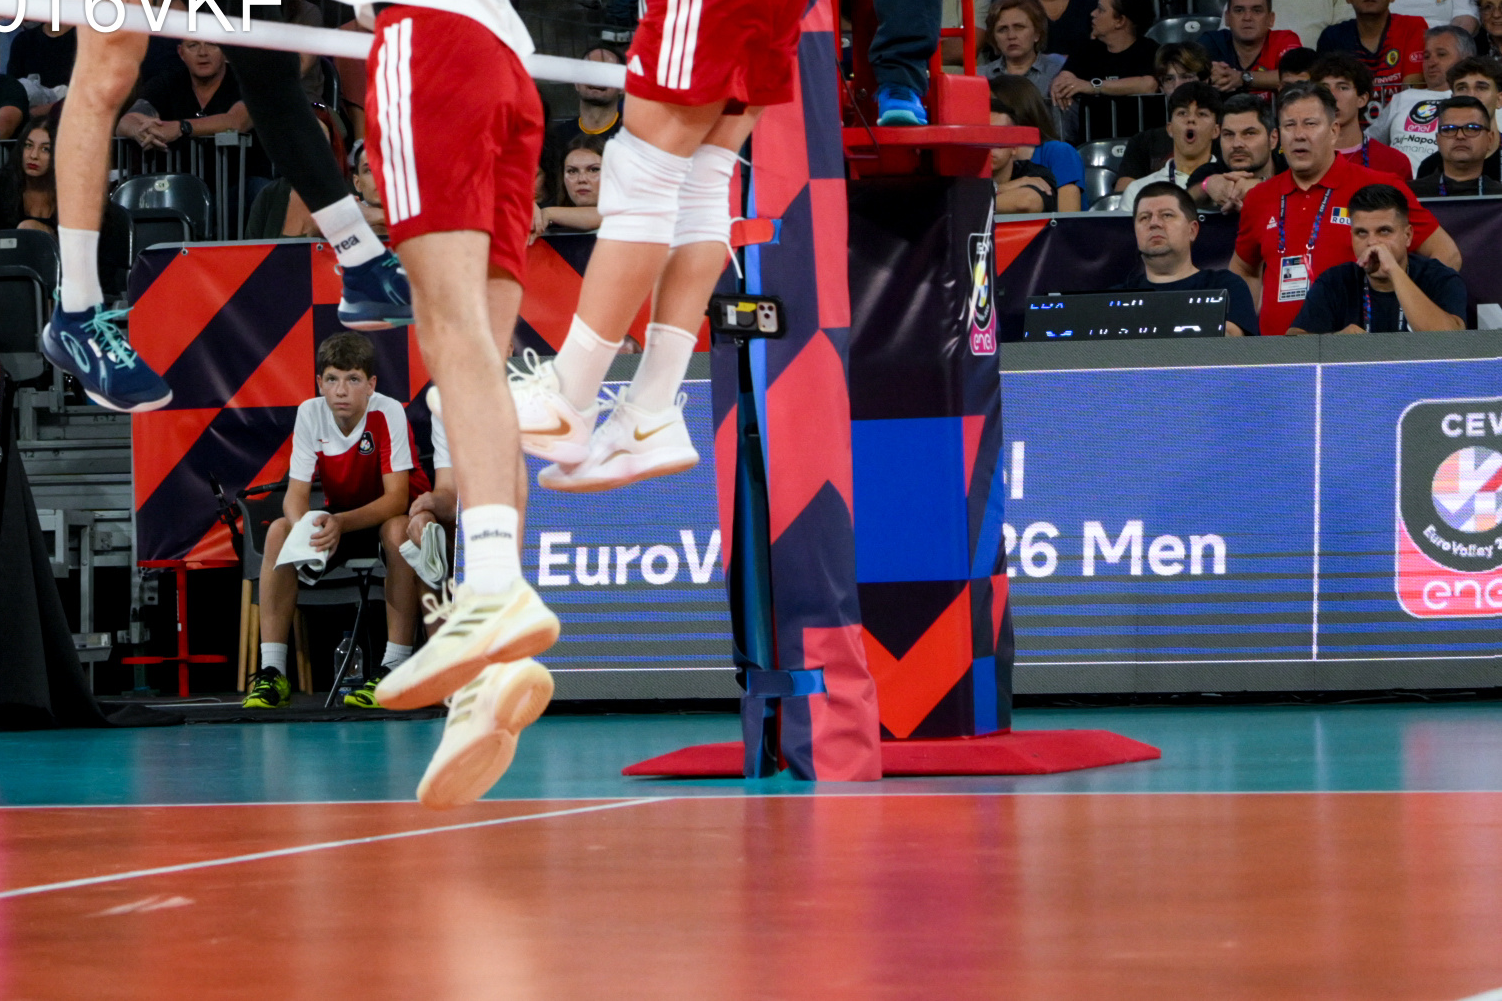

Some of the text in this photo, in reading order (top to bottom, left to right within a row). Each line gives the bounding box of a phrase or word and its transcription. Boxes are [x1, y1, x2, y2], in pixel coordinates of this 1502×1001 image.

[1407, 124, 1432, 133] enel
[973, 329, 994, 351] enel
[1441, 411, 1502, 438] CEV
[470, 529, 513, 542] adidas
[1422, 524, 1494, 559] EuroVolley
[536, 529, 723, 587] EuroV
[1081, 519, 1228, 578] Men
[1422, 578, 1502, 611] ene
